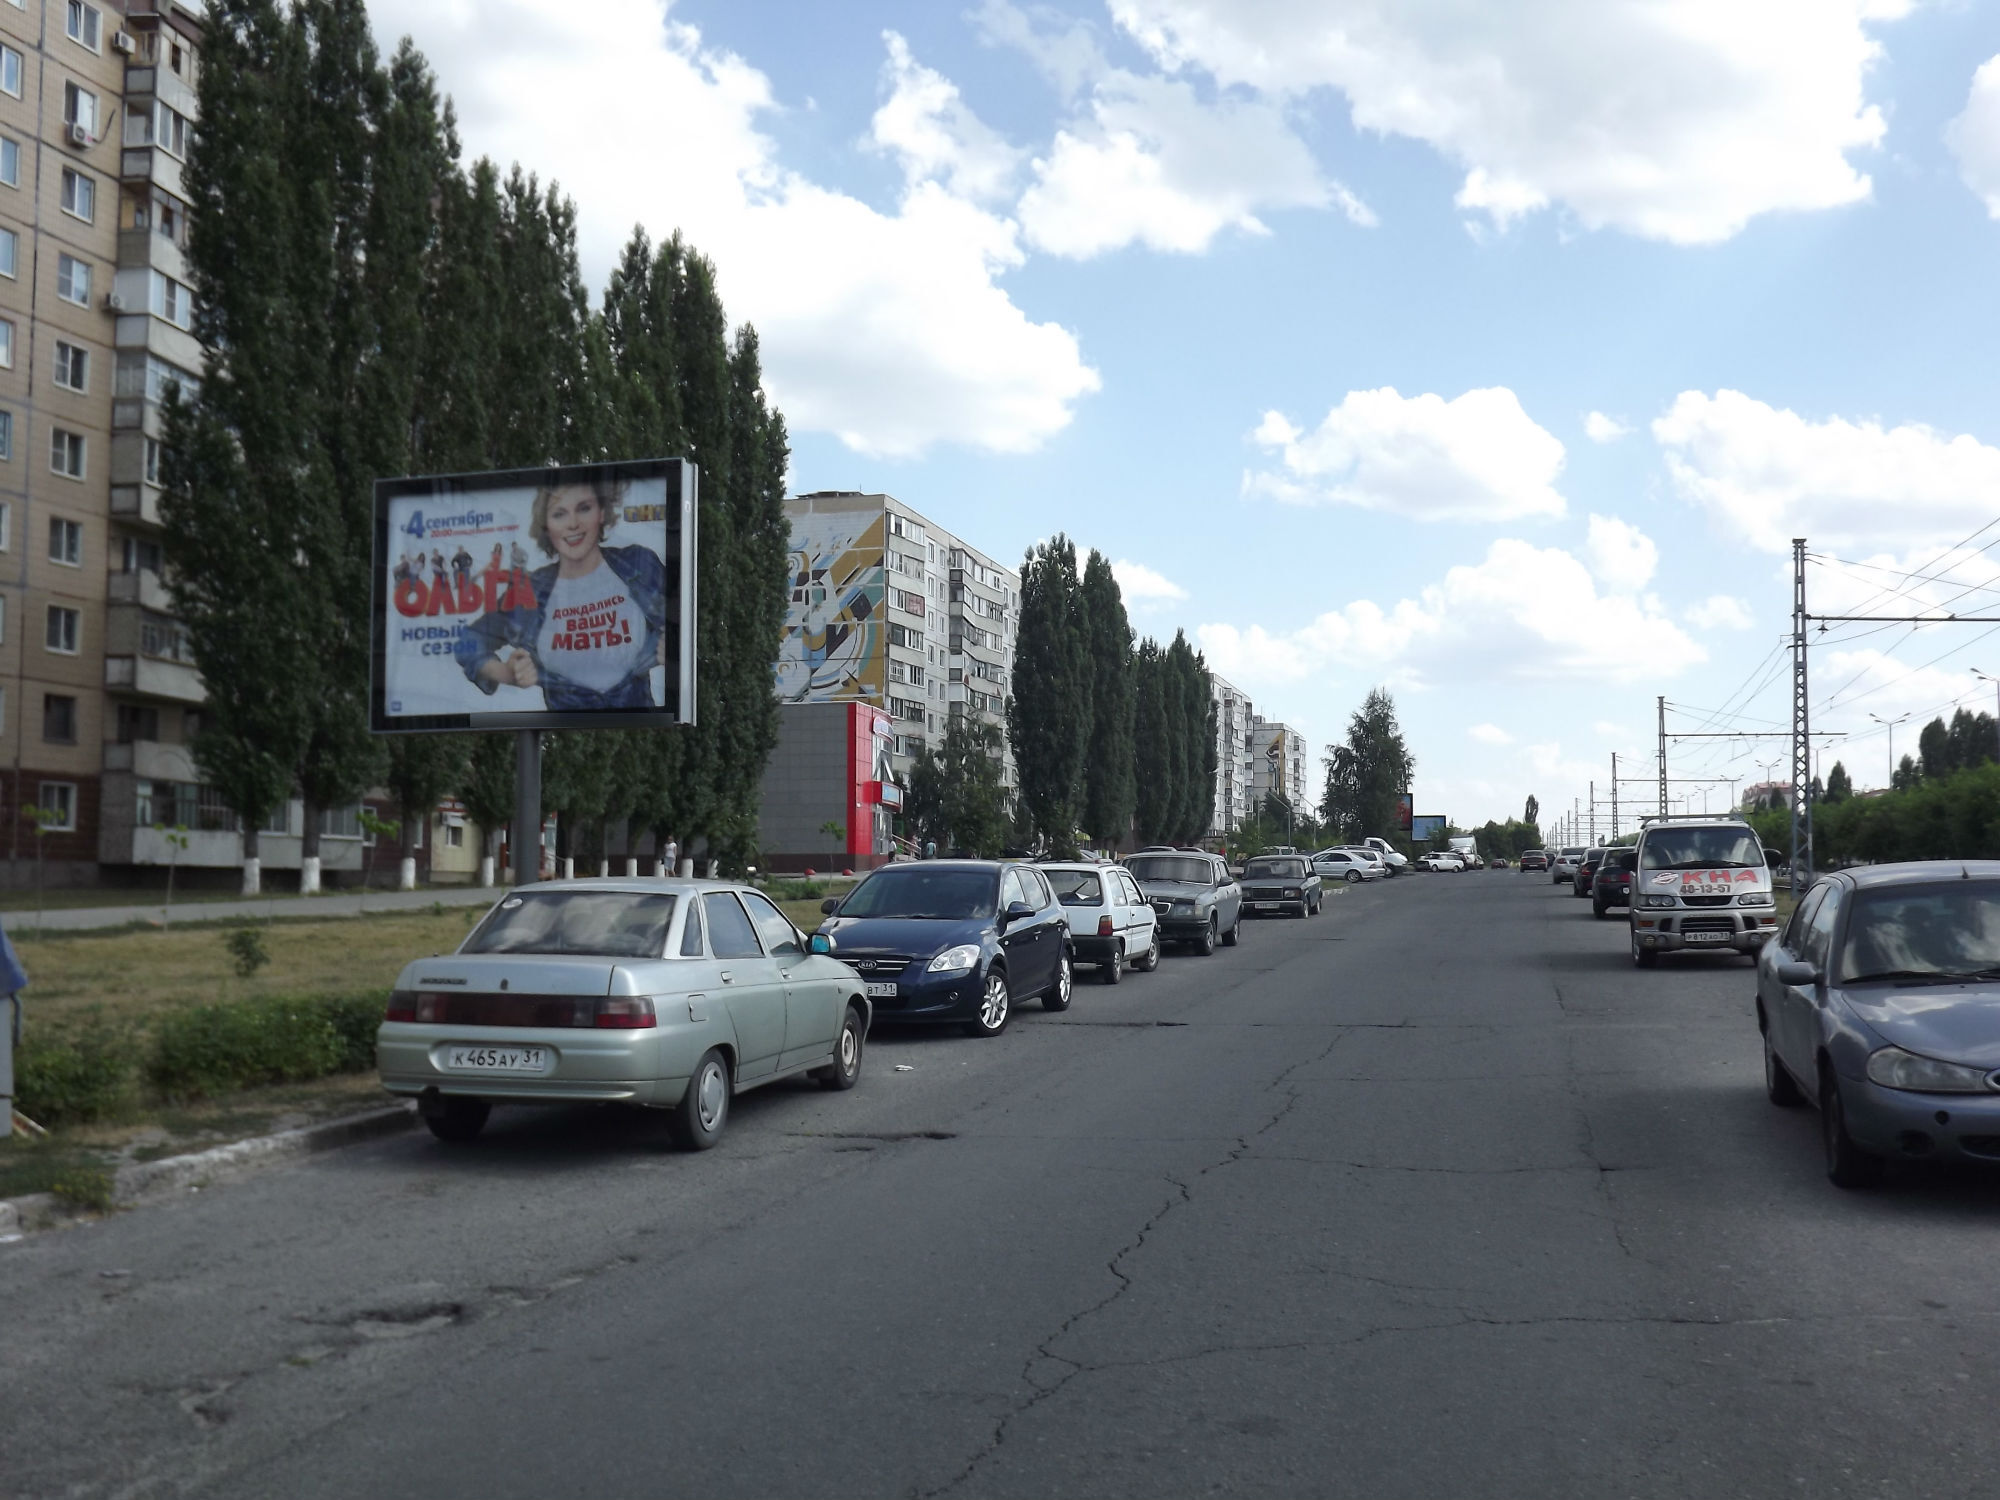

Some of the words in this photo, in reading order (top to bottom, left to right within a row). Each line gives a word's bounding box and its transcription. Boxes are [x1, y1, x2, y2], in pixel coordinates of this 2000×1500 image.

[407, 510, 425, 539] 4
[426, 509, 494, 530] сентября
[394, 569, 538, 617] ОЛЬГА
[552, 595, 625, 620] дождались
[401, 618, 469, 641] новый
[566, 610, 617, 632] вашу
[421, 639, 478, 656] сезон
[552, 619, 632, 651] мать!
